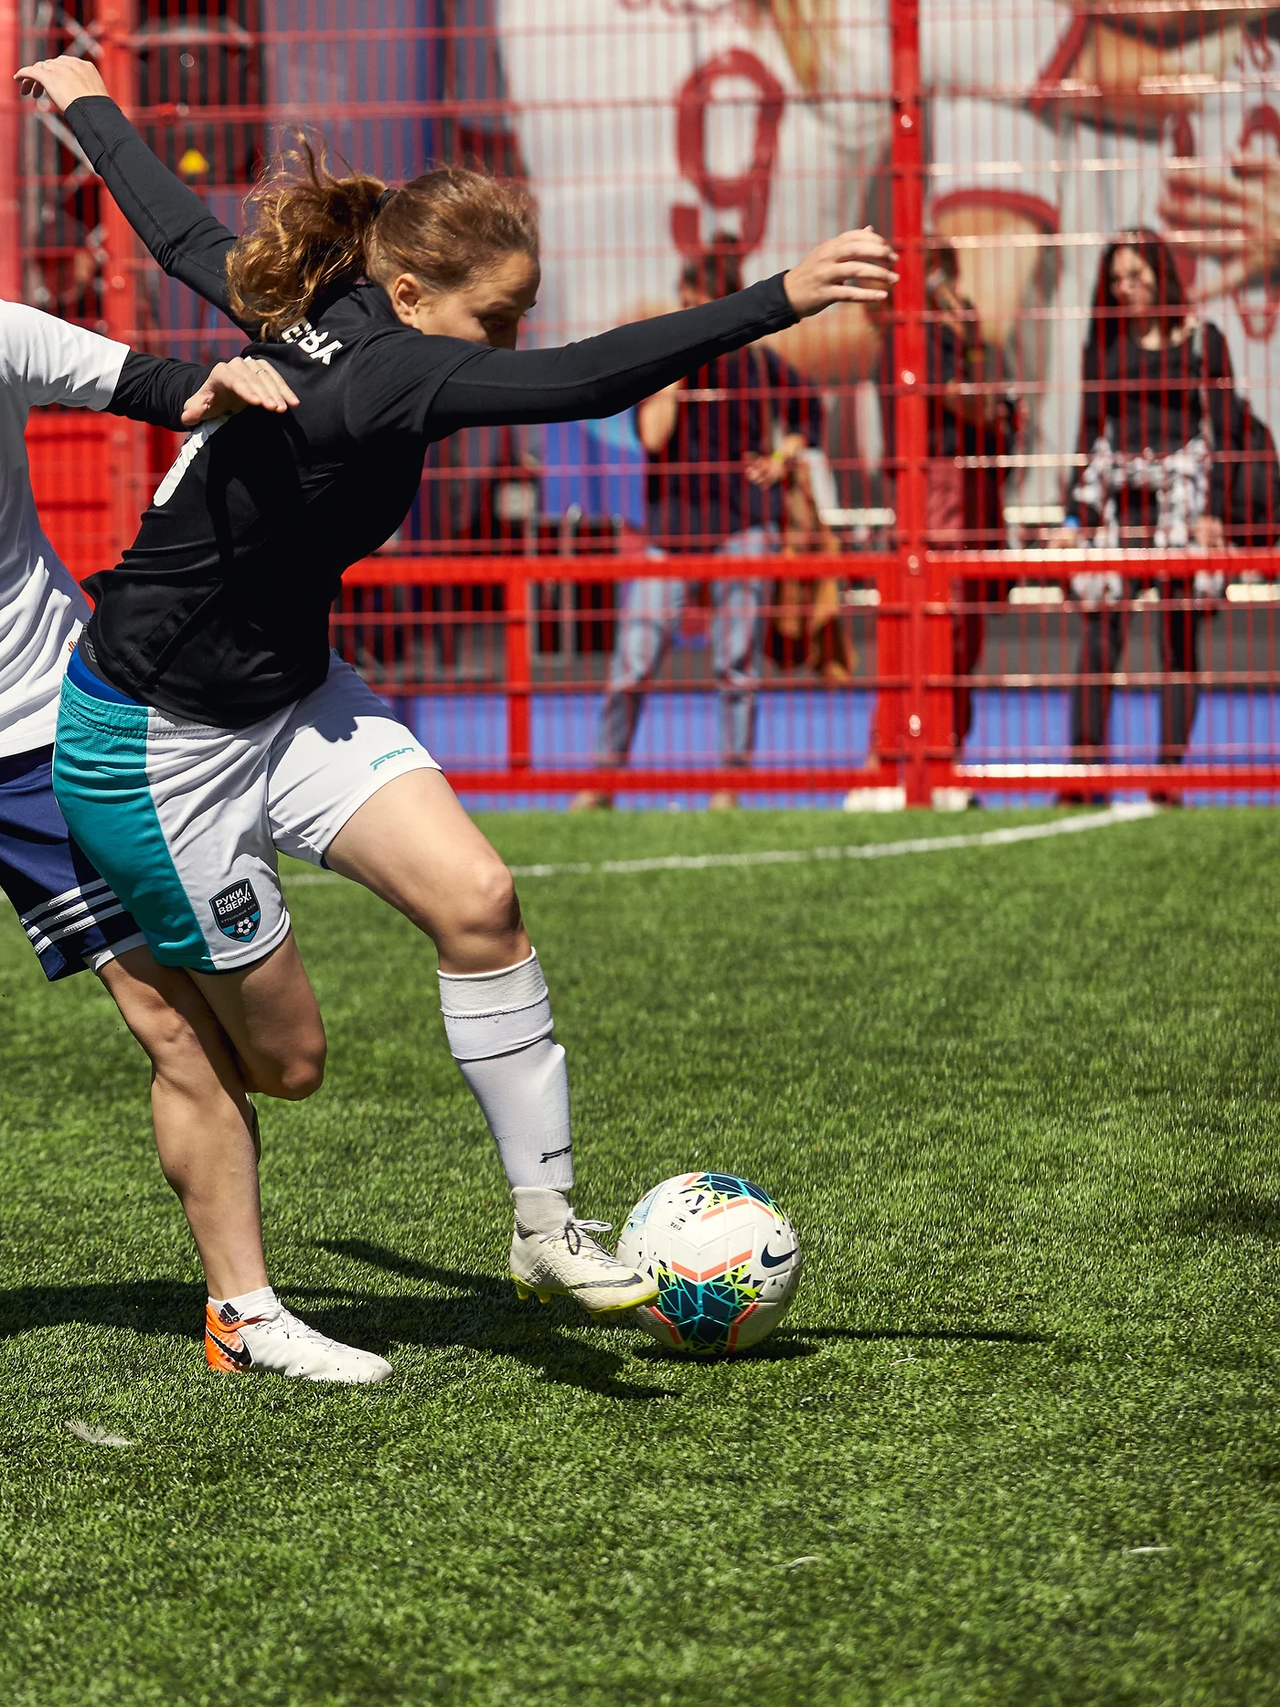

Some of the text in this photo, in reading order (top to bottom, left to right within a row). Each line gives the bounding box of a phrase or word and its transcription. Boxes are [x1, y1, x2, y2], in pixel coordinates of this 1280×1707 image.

[671, 46, 785, 258] 9
[215, 888, 244, 908] РУКИ
[218, 883, 252, 915] ВВЕРХ!
